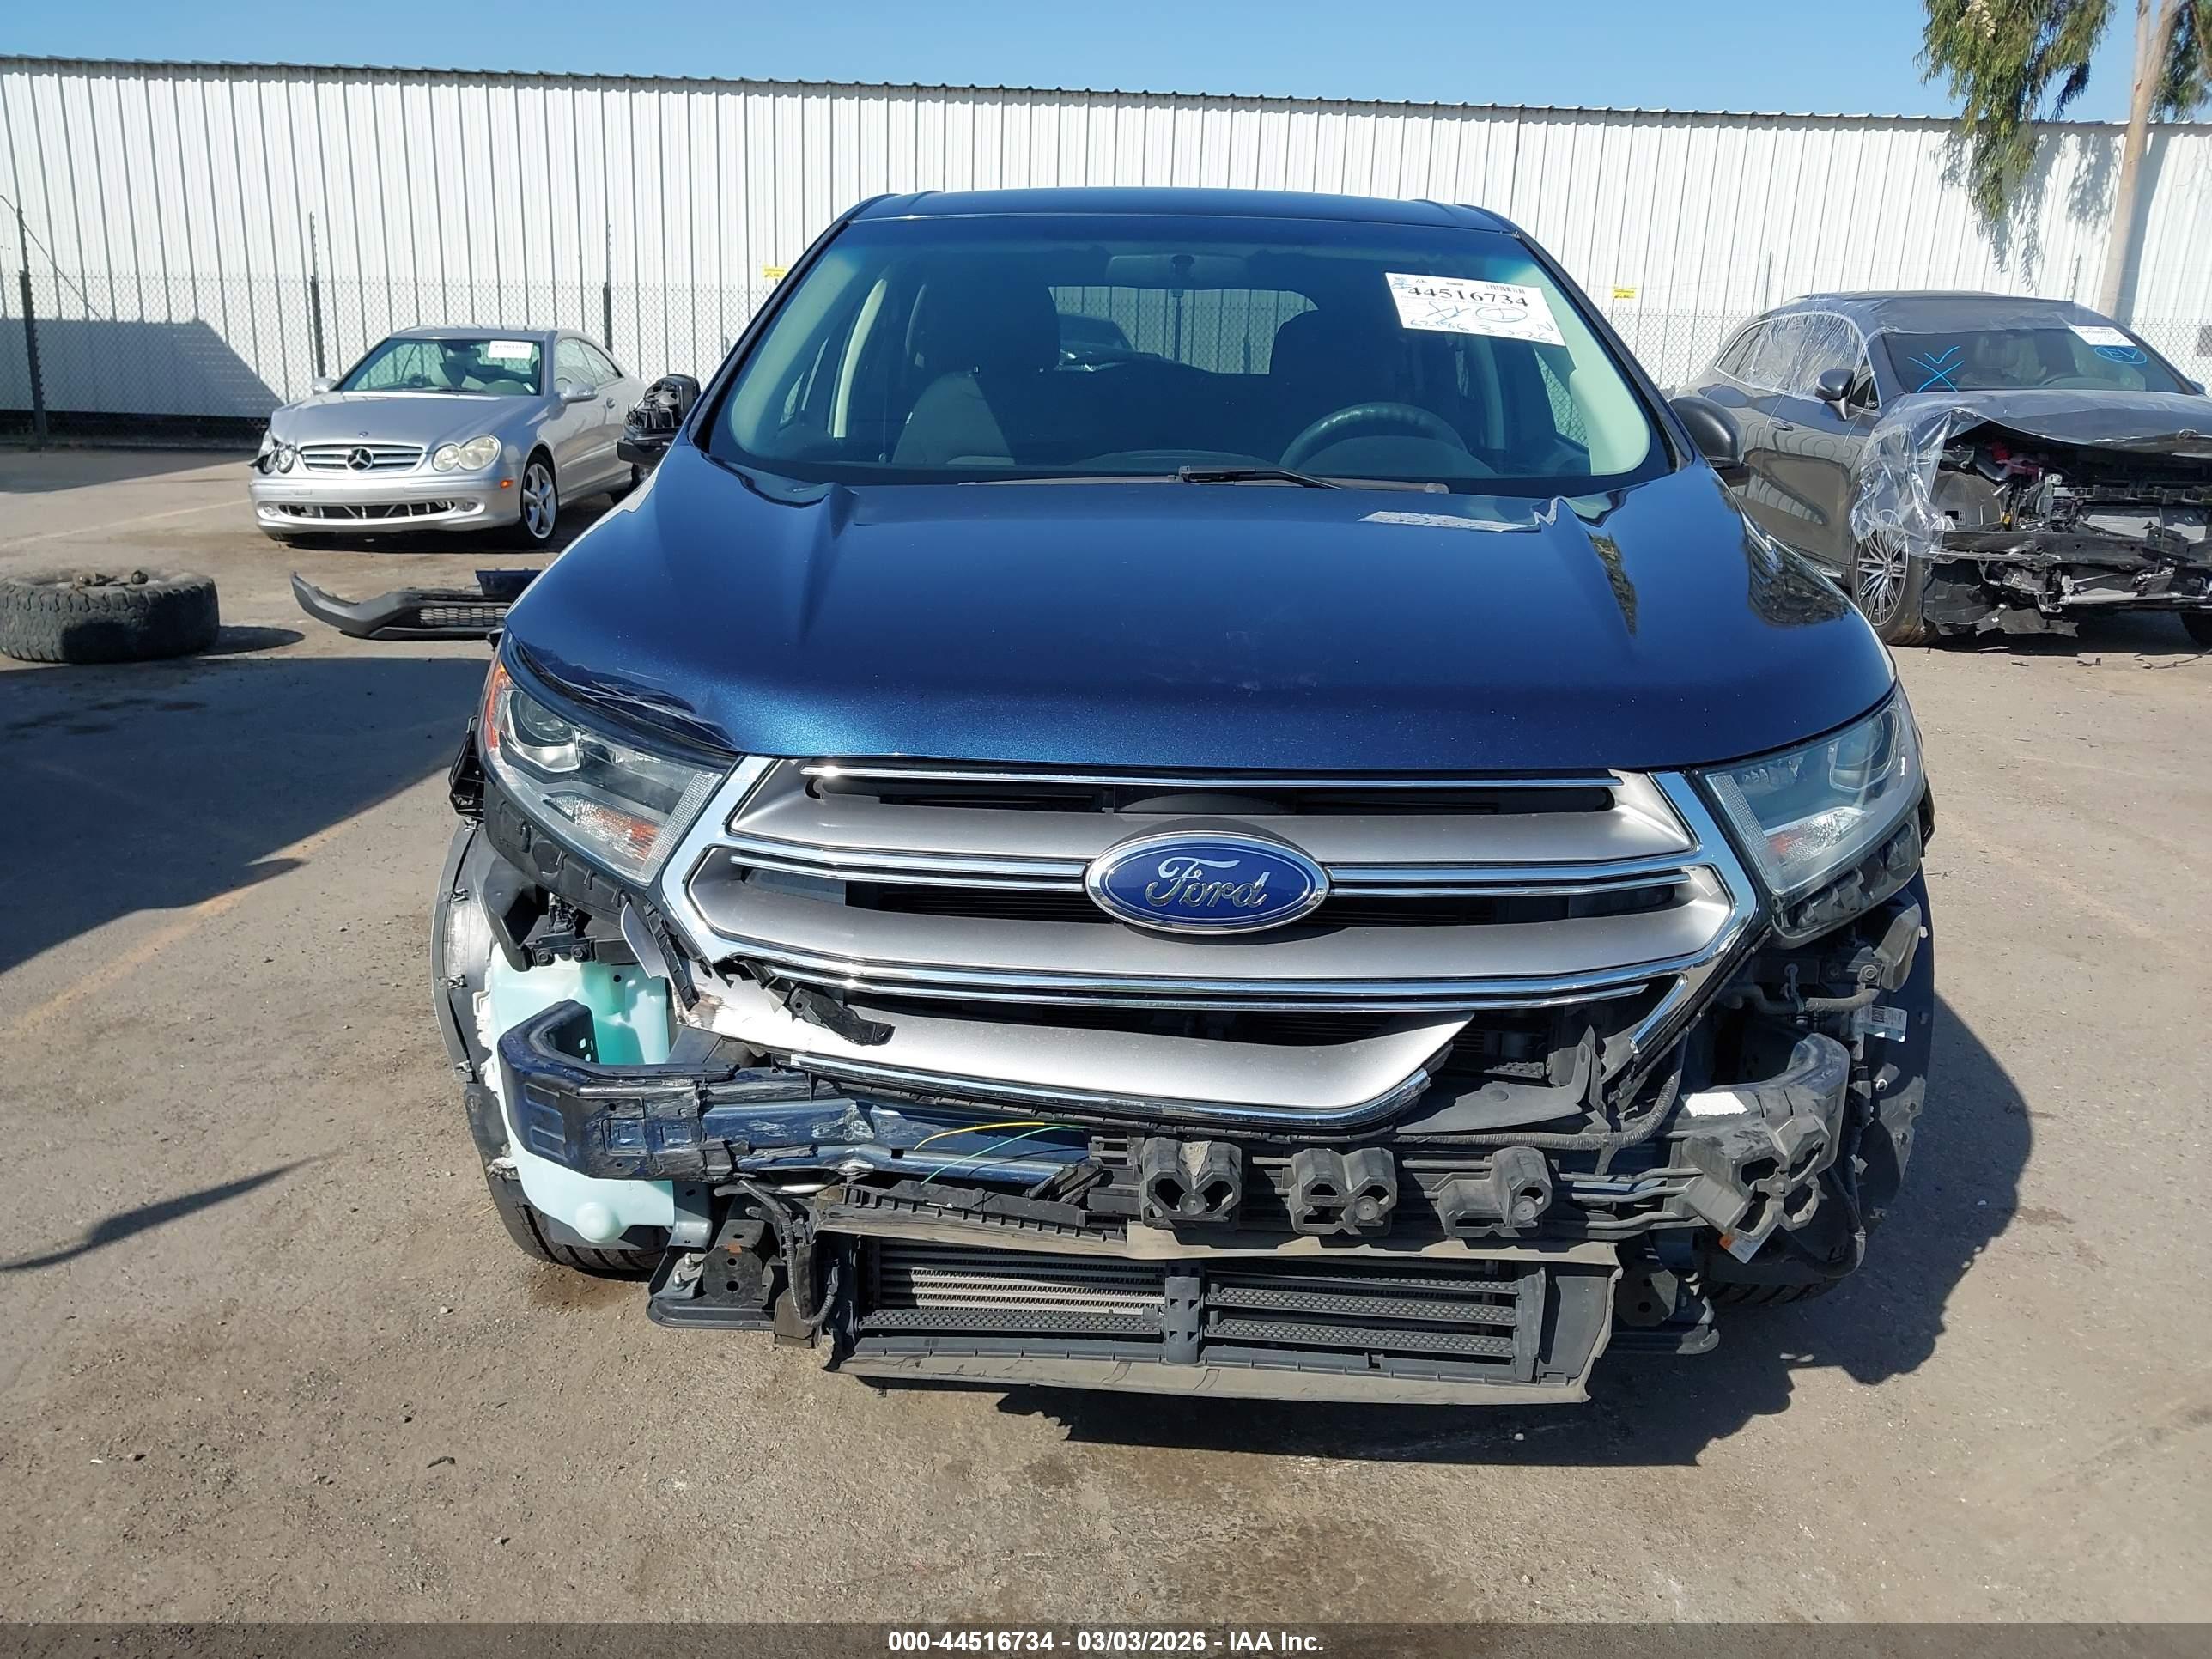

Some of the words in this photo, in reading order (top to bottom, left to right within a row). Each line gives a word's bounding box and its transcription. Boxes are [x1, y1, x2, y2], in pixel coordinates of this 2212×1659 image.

[1407, 286, 1529, 307] 44516734
[2102, 347, 2139, 360] EV
[1146, 855, 1271, 908] Ford
